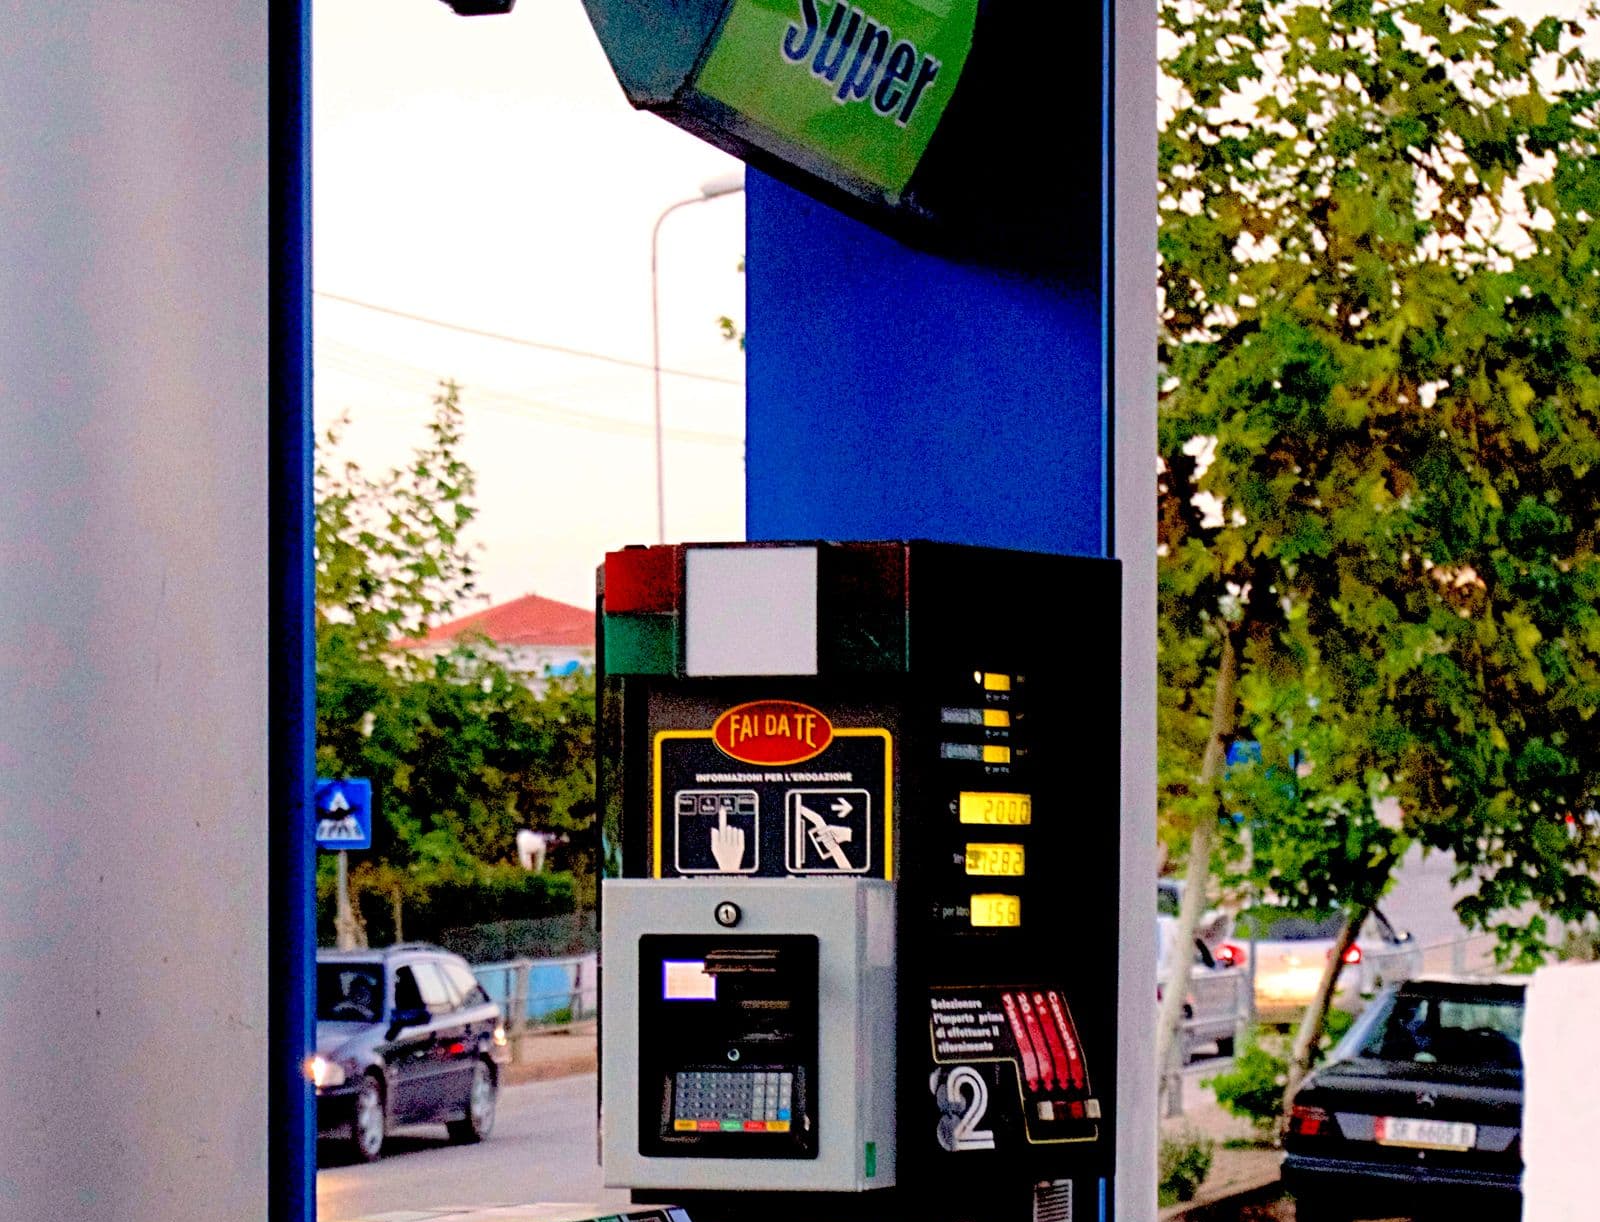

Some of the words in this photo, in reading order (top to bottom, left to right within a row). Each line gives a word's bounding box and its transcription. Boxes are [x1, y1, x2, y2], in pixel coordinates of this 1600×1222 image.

[781, 0, 938, 126] Super
[730, 714, 760, 749] FAI
[765, 713, 791, 738] DA
[794, 714, 817, 749] TE
[695, 773, 763, 783] INFORMAZIONI
[764, 772, 783, 782] PER
[933, 1013, 975, 1026] l'importo
[978, 1011, 1005, 1025] prima
[935, 1027, 946, 1039] di
[947, 1026, 991, 1038] effettuare
[992, 1025, 1000, 1037] il
[938, 1041, 994, 1053] rifornimento
[943, 1065, 996, 1150] 2
